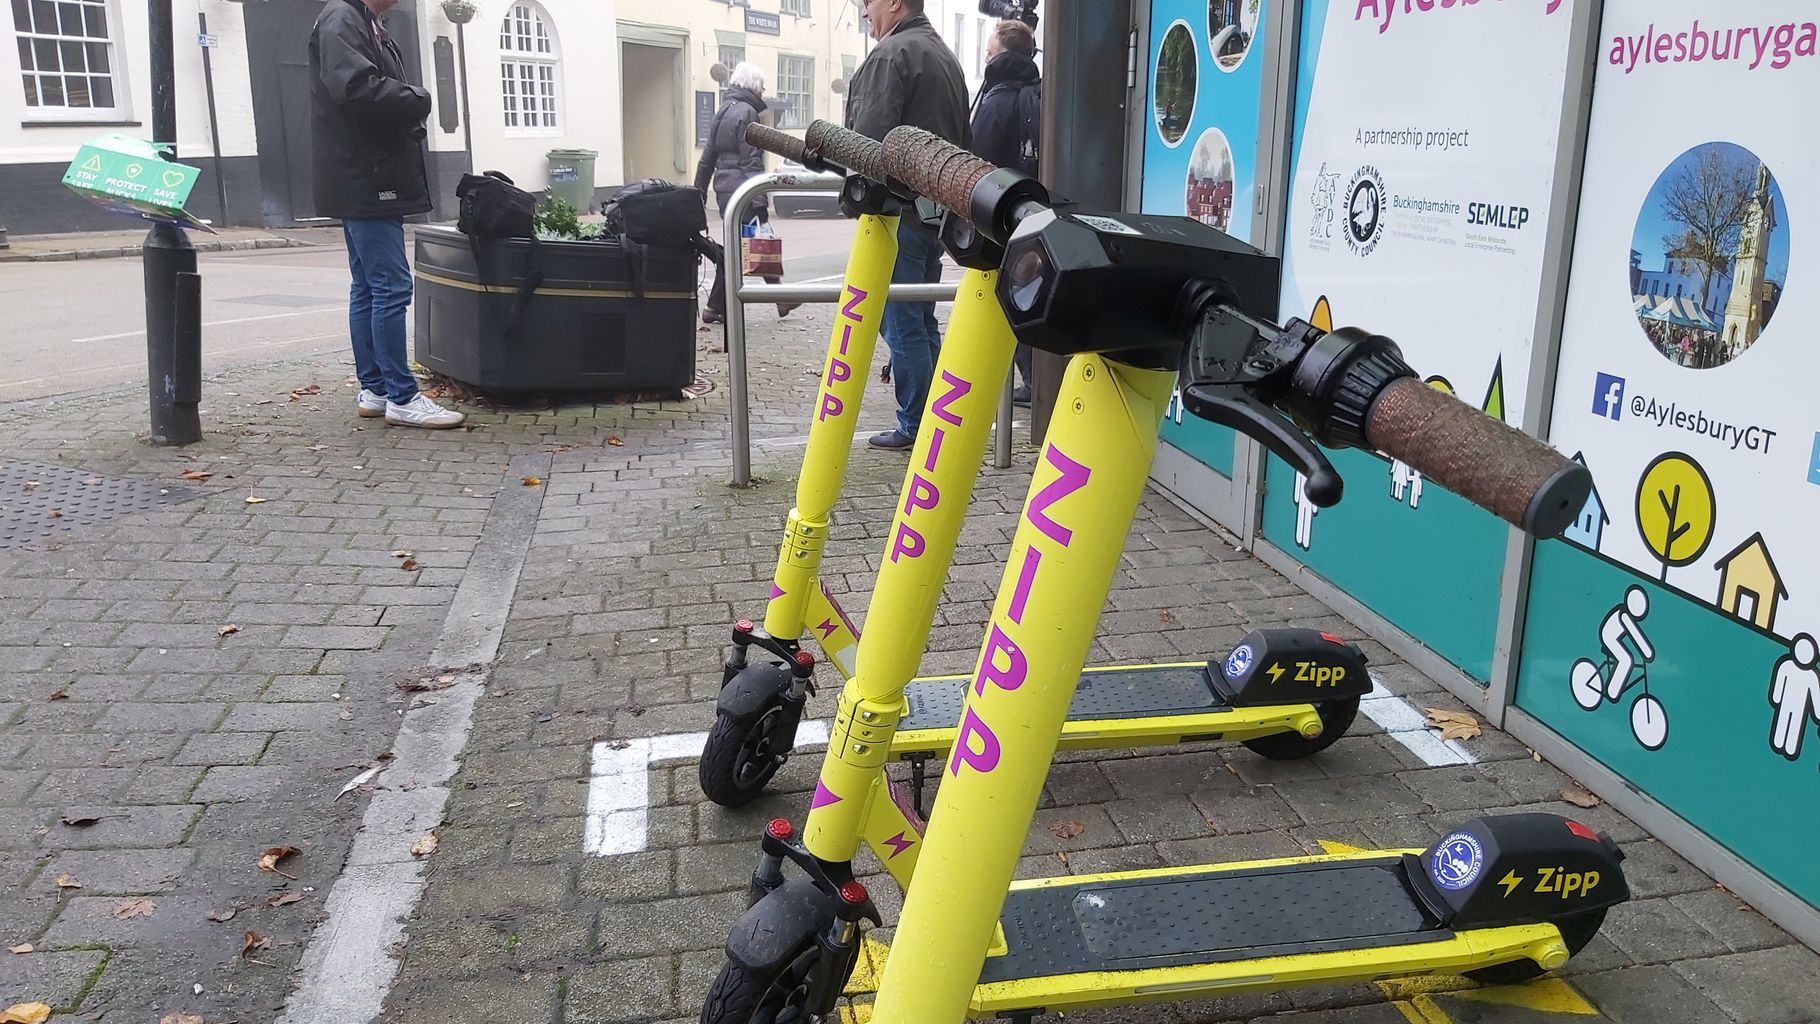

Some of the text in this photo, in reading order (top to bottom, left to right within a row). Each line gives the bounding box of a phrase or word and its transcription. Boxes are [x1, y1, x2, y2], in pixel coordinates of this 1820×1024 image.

[1354, 127, 1469, 151] A partnership project
[76, 171, 98, 181] STAY
[105, 177, 148, 193] PROTECT
[1343, 165, 1387, 214] BUCKINGHAMSHIRE
[153, 188, 178, 200] SAVE
[1393, 194, 1460, 215] Buckinghamshire
[1467, 202, 1529, 229] SEMLEP
[1342, 217, 1360, 256] COUNTY
[1361, 222, 1385, 257] COUNCIL
[819, 284, 868, 422] ZIPP
[1631, 395, 1777, 454] @AylesburyGT
[891, 369, 972, 564] ZIPP
[950, 441, 1092, 778] ZIPP
[1294, 661, 1346, 687] Zipp
[1435, 833, 1482, 887] BUCKINGHAMSHIRE COUNCIL
[1534, 866, 1600, 899] Zipp
